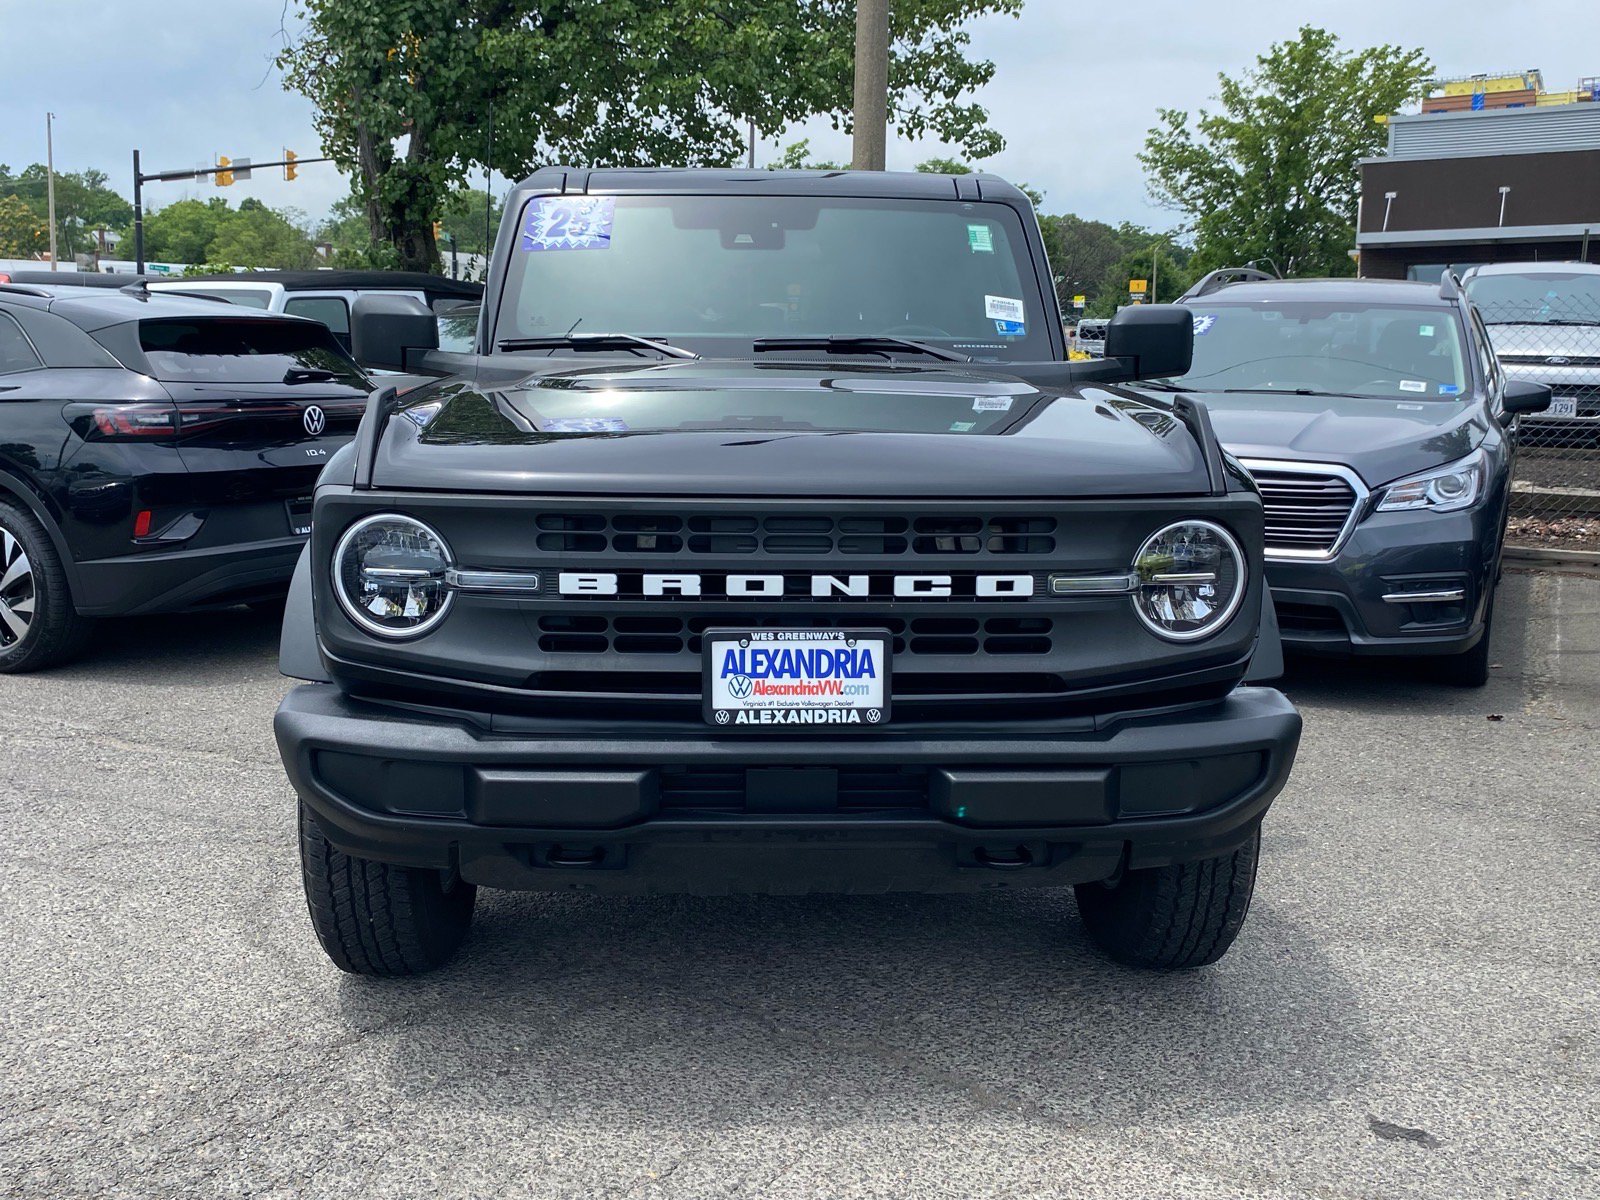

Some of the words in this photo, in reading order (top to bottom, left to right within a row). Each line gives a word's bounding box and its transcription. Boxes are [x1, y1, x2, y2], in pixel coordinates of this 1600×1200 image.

[558, 572, 1034, 596] BRONCO
[751, 632, 774, 640] WES
[777, 632, 845, 640] GREENWAY'S
[720, 649, 876, 678] ALEXANDRIA
[753, 679, 870, 695] AlexandriaVW.com
[742, 700, 766, 708] Virginia's
[800, 700, 833, 709] Volkswagen
[735, 710, 861, 724] ALEXANDRIA
